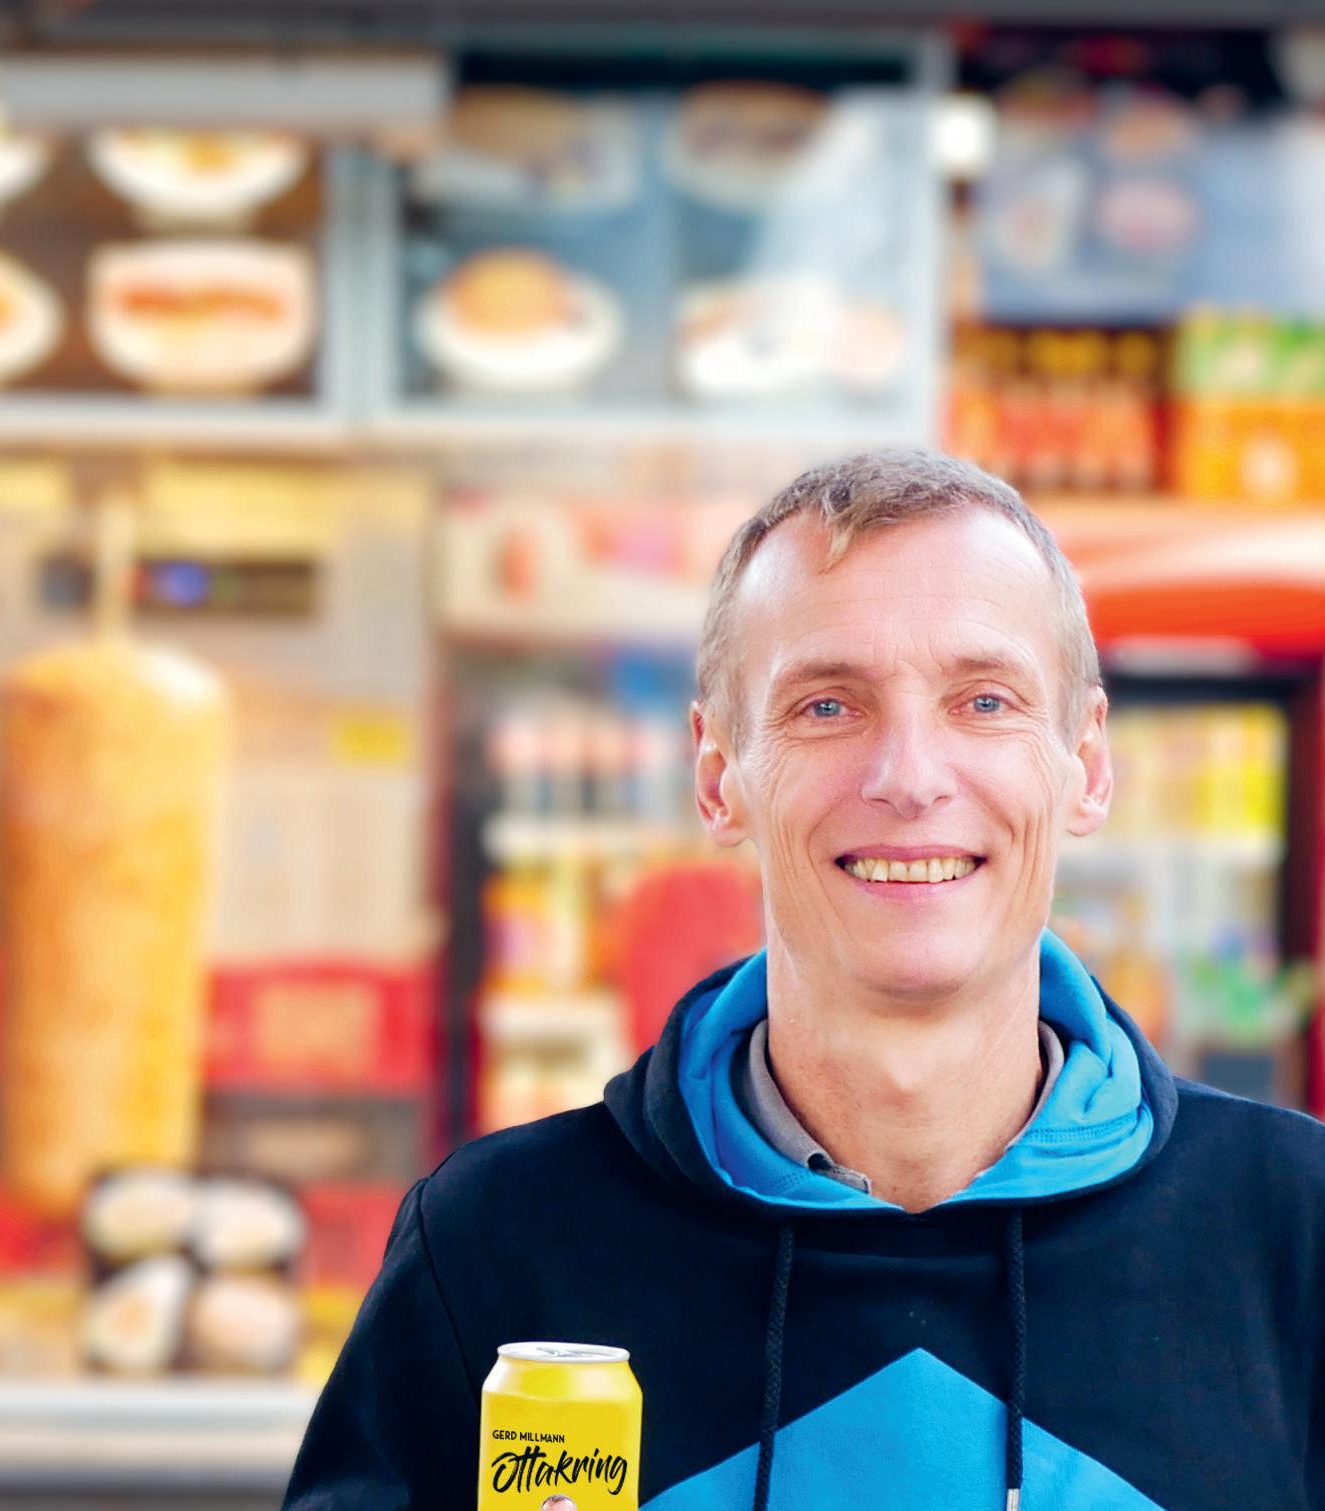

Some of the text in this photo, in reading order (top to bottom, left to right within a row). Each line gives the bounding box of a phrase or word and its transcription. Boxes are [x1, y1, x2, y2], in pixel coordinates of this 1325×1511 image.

[492, 1429, 565, 1444] GERD MILLMANN
[491, 1445, 628, 1496] Ottakring
